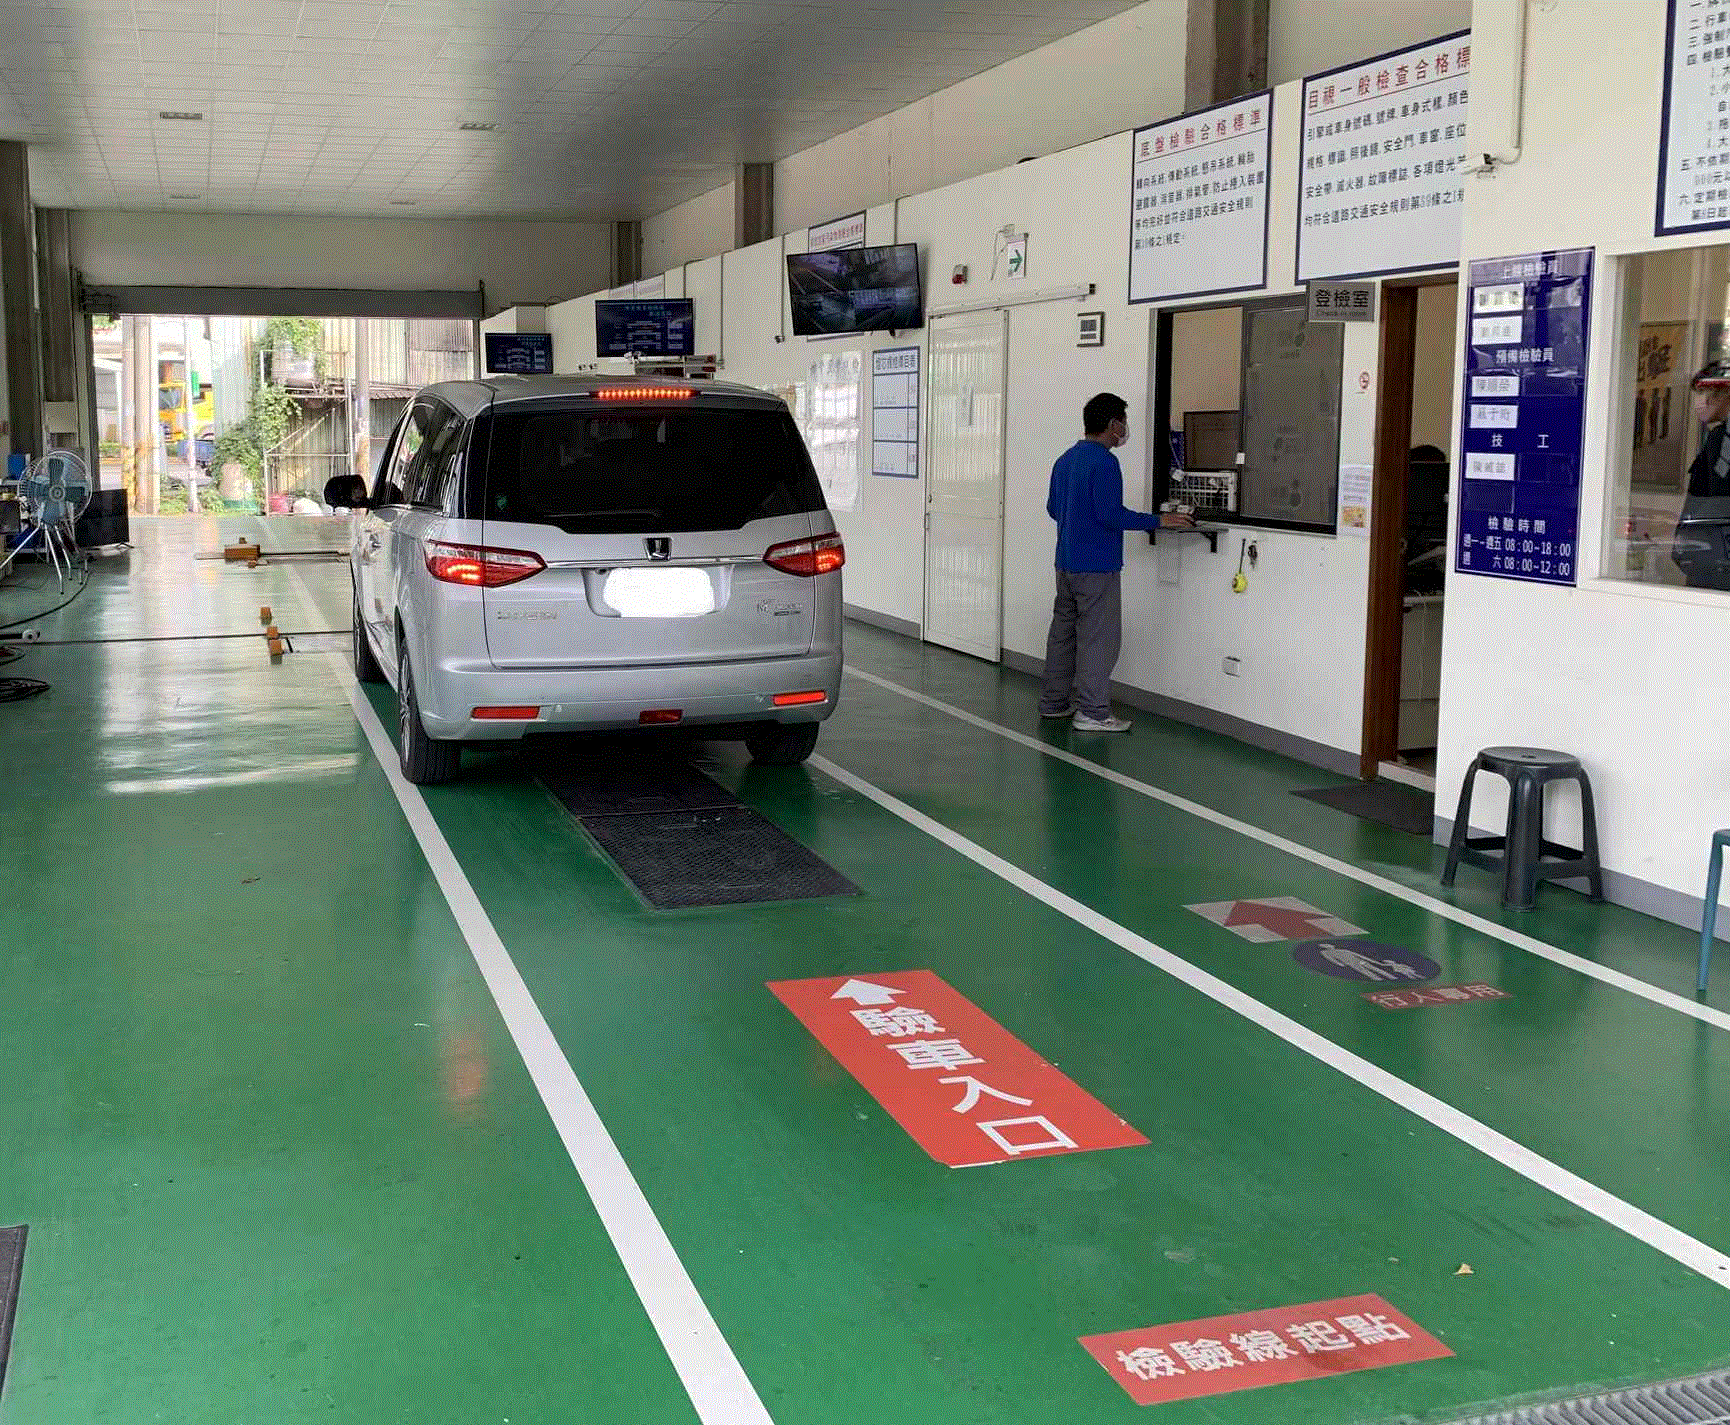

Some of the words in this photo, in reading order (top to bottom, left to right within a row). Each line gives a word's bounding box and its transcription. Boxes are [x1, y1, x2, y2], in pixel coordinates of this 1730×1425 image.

[1139, 107, 1262, 158] 底盤檢驗合格標準
[1315, 288, 1369, 307] 登檢室
[1488, 516, 1546, 535] 檢驗時間
[1371, 984, 1505, 1008] 行人專用
[849, 1006, 1079, 1156] 驗車入口
[1116, 1312, 1412, 1381] 檢驗線起點
